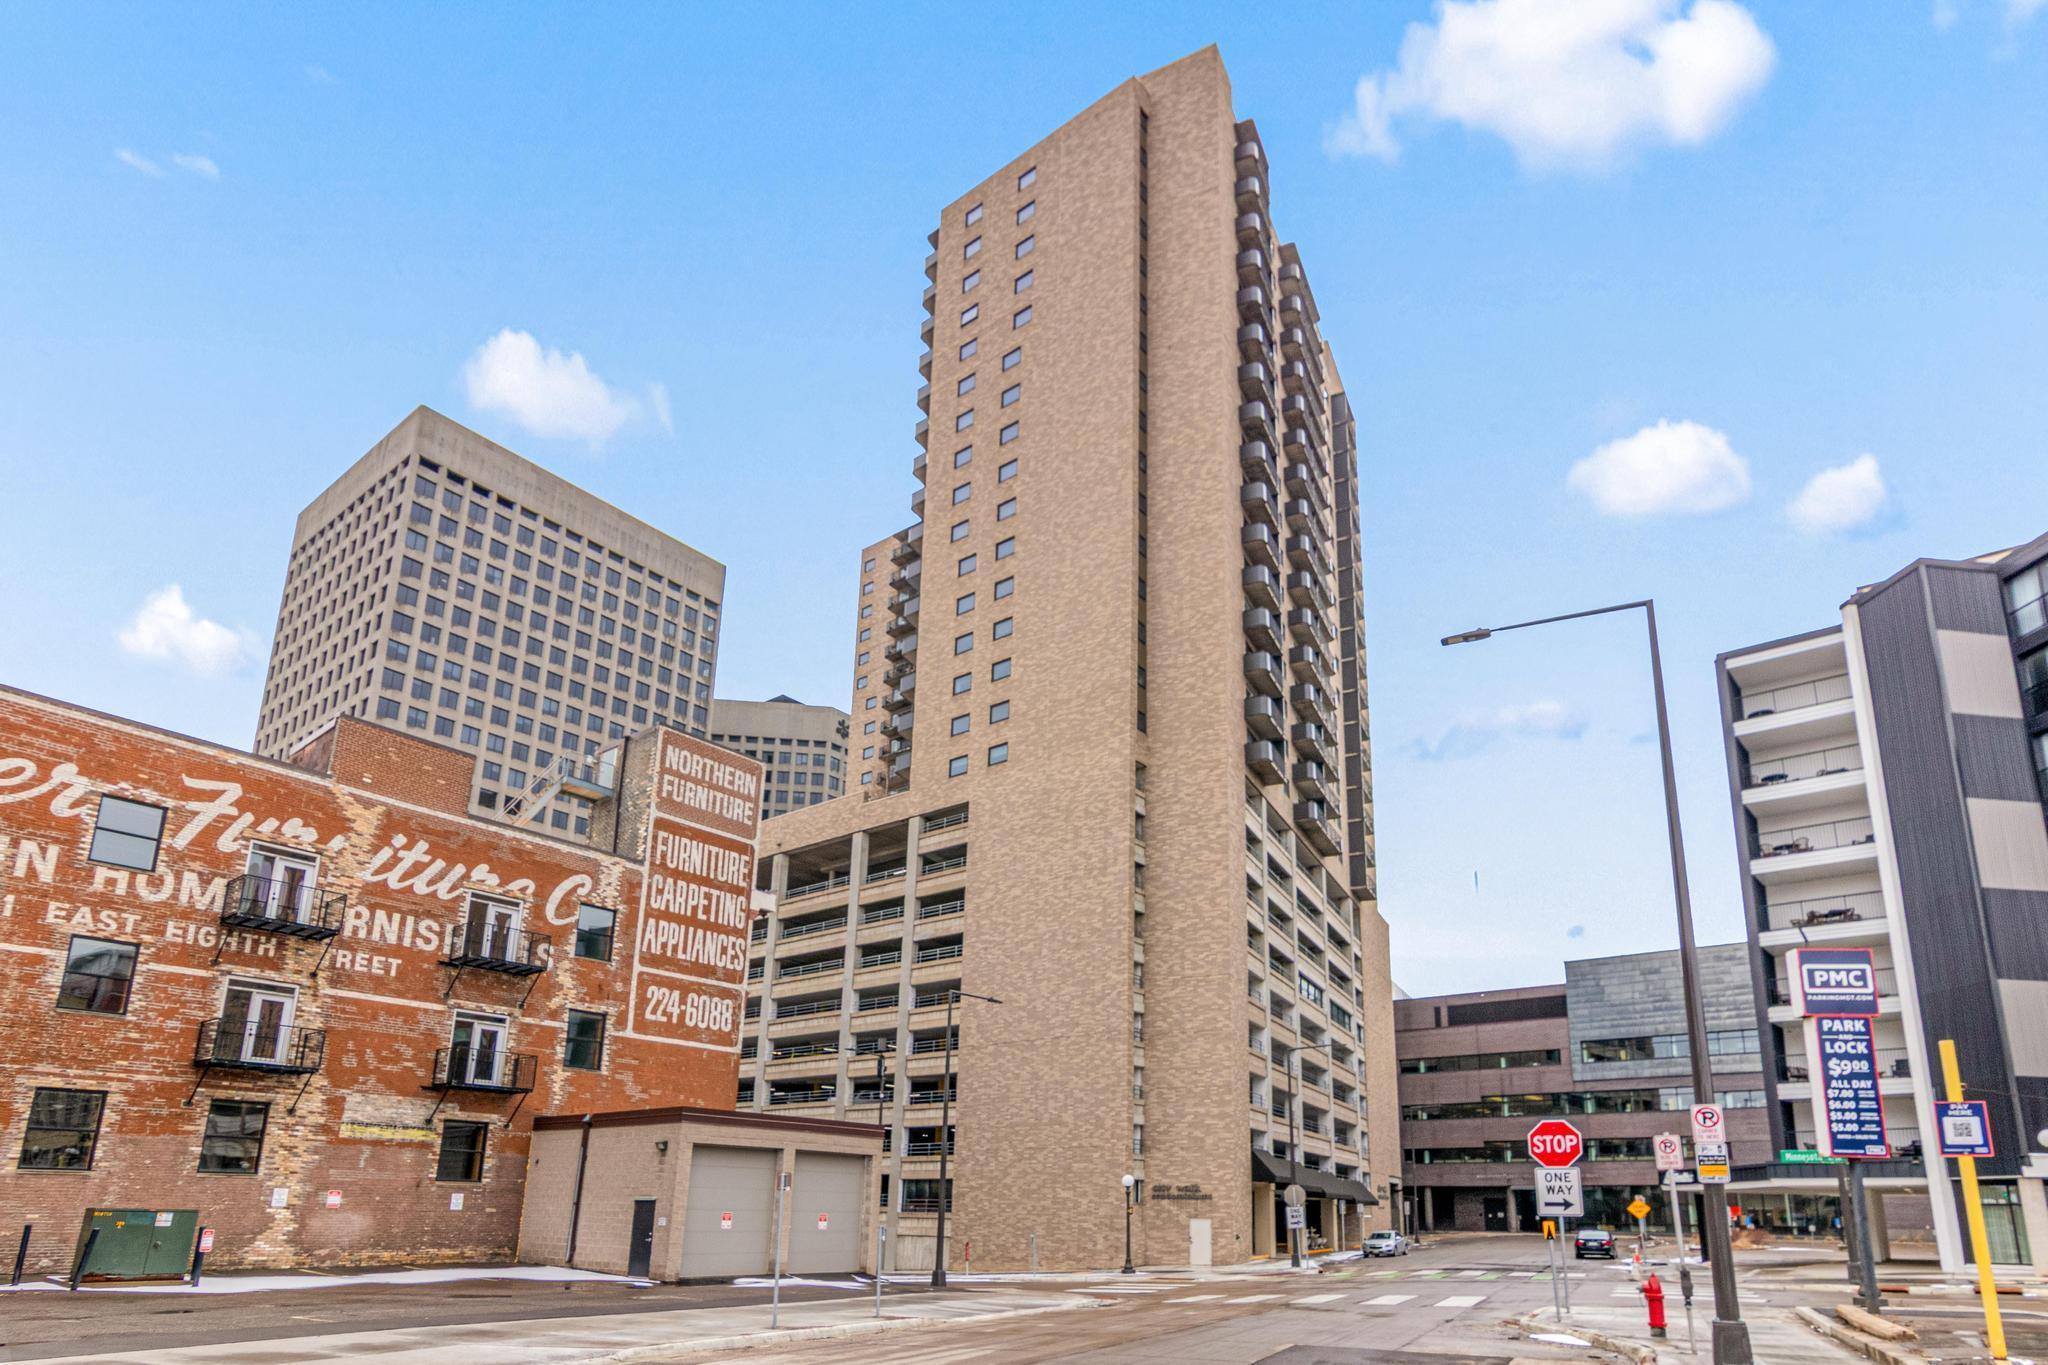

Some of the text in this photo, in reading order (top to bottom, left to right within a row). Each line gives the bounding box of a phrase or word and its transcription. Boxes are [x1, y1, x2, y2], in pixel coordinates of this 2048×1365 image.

[664, 744, 756, 798] NORTHERN
[661, 773, 754, 826] FURNITURE
[655, 831, 750, 888] FURNITURE
[650, 874, 747, 930] CARPETING
[45, 901, 142, 935] EAST
[165, 920, 279, 958] EIGHTH
[642, 917, 746, 972] APPLIANCES
[1813, 969, 1864, 988] PMC
[644, 985, 733, 1033] 224-6088
[1821, 1018, 1867, 1033] PARK
[1824, 1041, 1869, 1055] LOCK
[1830, 1079, 1873, 1089] ALL DAY
[1532, 1134, 1578, 1154] STOP
[1544, 1172, 1572, 1184] ONE
[1545, 1184, 1574, 1196] WAY
